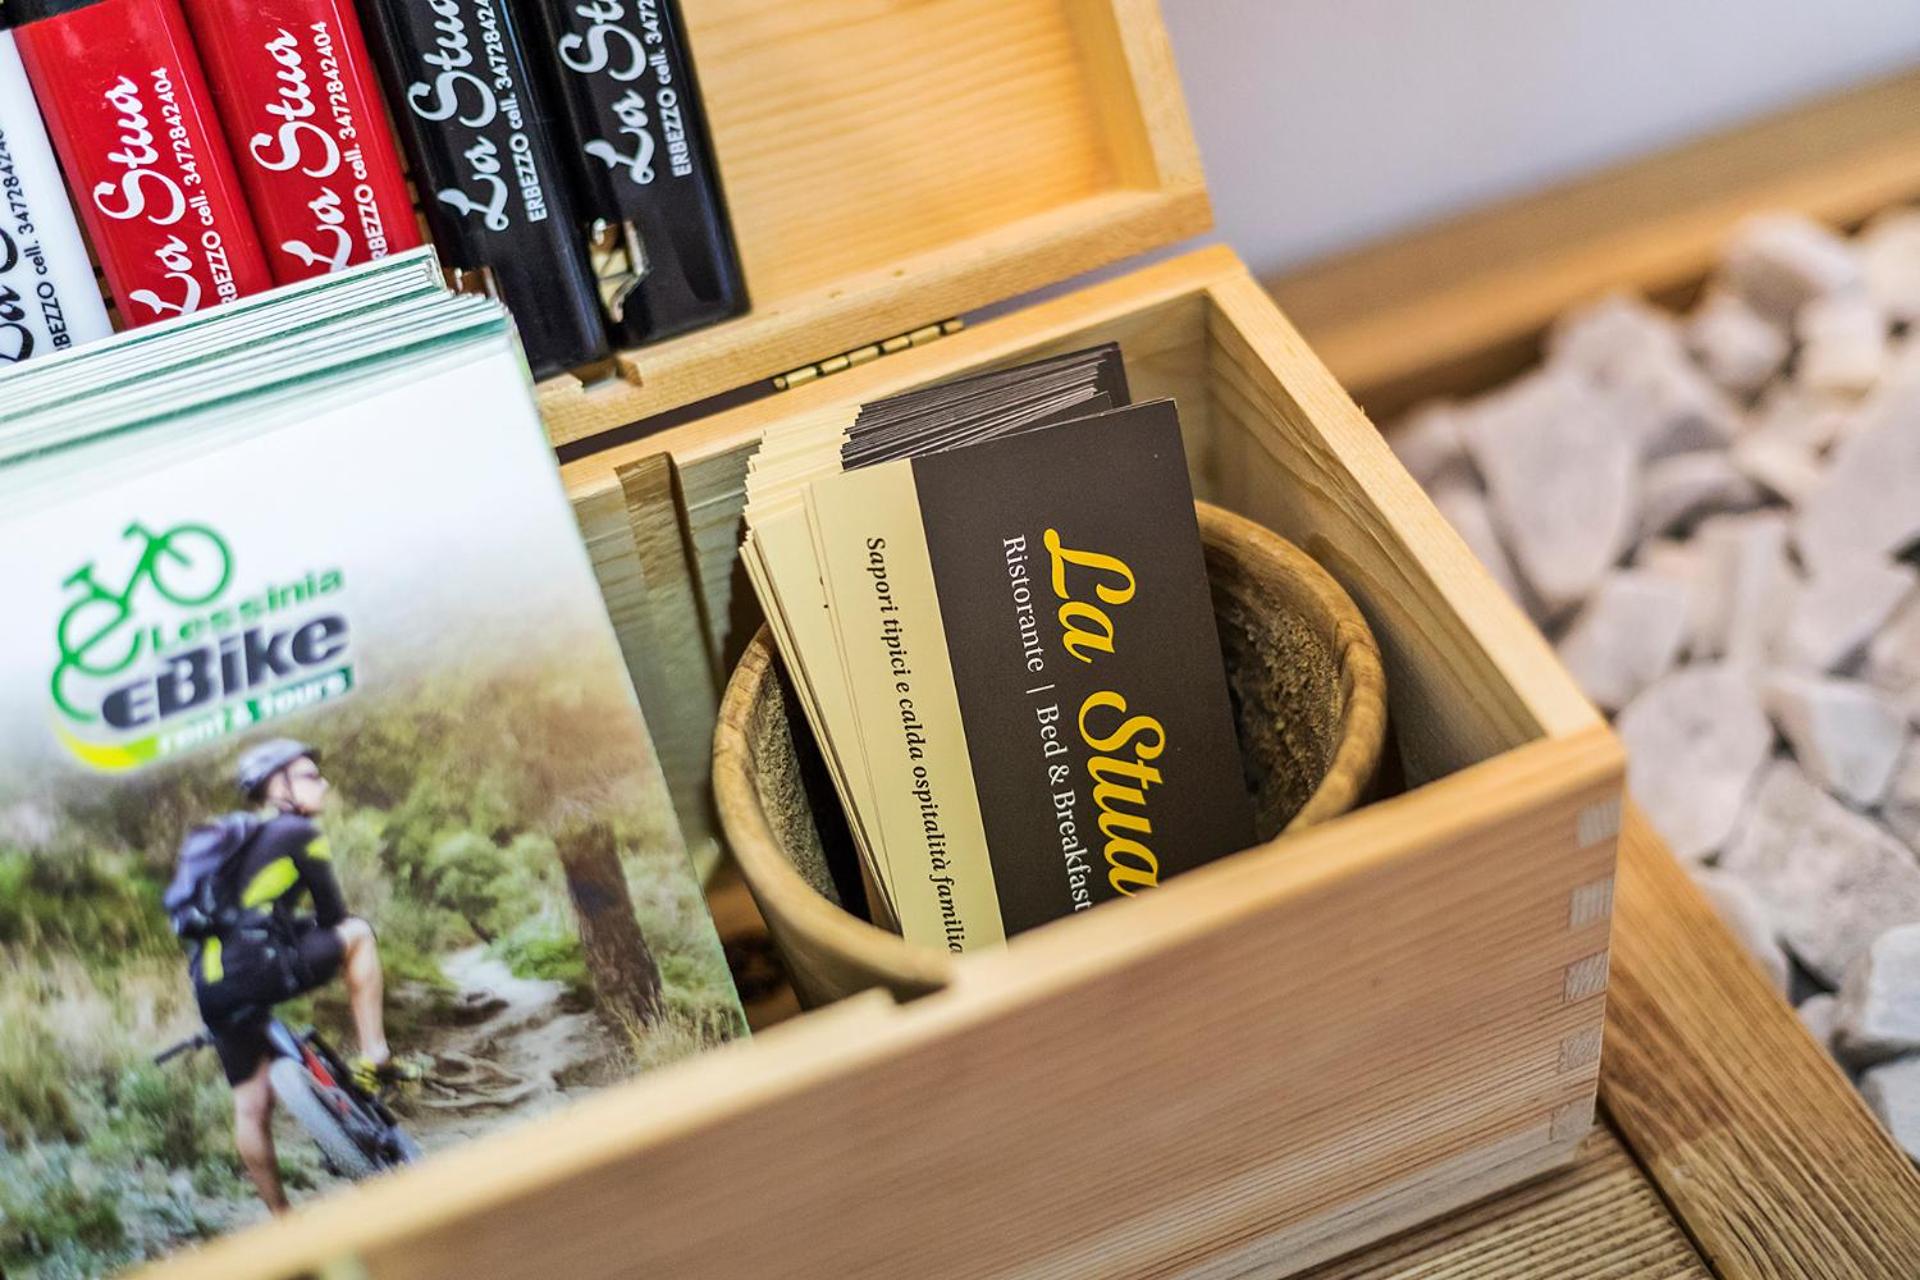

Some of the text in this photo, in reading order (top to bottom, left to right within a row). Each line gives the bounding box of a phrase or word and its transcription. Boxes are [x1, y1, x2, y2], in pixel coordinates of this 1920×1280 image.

[310, 21, 357, 140] 3472842404
[499, 91, 524, 130] cell.
[649, 47, 672, 85] cell.
[150, 67, 201, 185] 3472842404
[249, 28, 352, 274] La Stua
[344, 142, 369, 182] cell.
[584, 89, 655, 185] La
[656, 88, 692, 177] ERBEZZO
[93, 76, 201, 315] La Stua
[189, 187, 216, 229] cell.
[437, 135, 509, 231] La
[508, 133, 548, 223] ERBEZZO
[37, 281, 73, 352] BEZZO
[867, 538, 897, 613] Sapori
[1002, 534, 1045, 673] Ristorante
[881, 616, 911, 681] tipici
[896, 680, 911, 693] e
[898, 698, 925, 761] calda
[1036, 702, 1068, 758] Bed
[1042, 527, 1165, 897] La Stua
[912, 764, 947, 872] ospitalità
[1047, 764, 1071, 785] &
[1053, 789, 1093, 912] Breakfast
